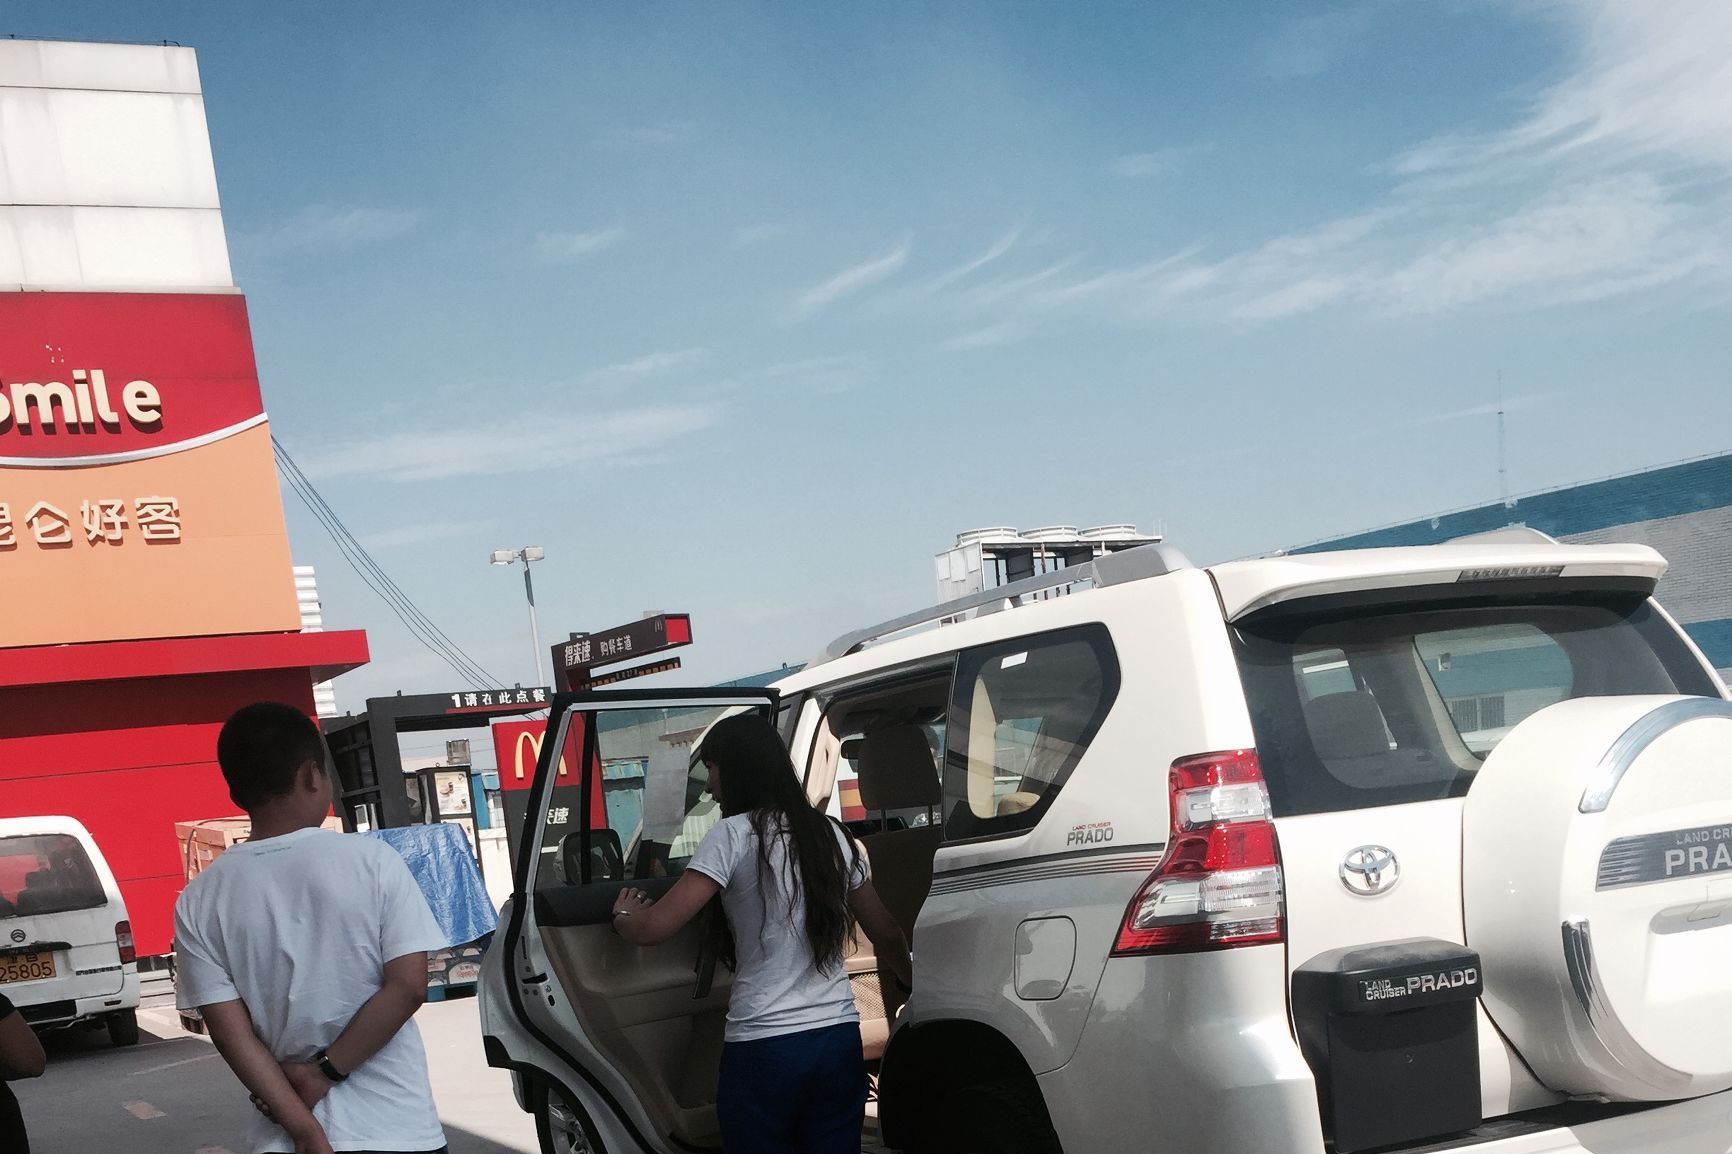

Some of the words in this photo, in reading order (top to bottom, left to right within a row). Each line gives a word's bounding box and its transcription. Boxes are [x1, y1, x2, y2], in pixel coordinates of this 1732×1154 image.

[564, 640, 591, 667] 得来速
[600, 634, 633, 657] 购餐车道
[1066, 827, 1114, 847] PRADO
[1676, 830, 1710, 845] LAND
[1665, 842, 1732, 876] PRA
[0, 961, 53, 981] 25805
[1406, 967, 1478, 995] PRADO
[1365, 980, 1392, 992] LAND
[1365, 986, 1407, 1001] CRUISER
